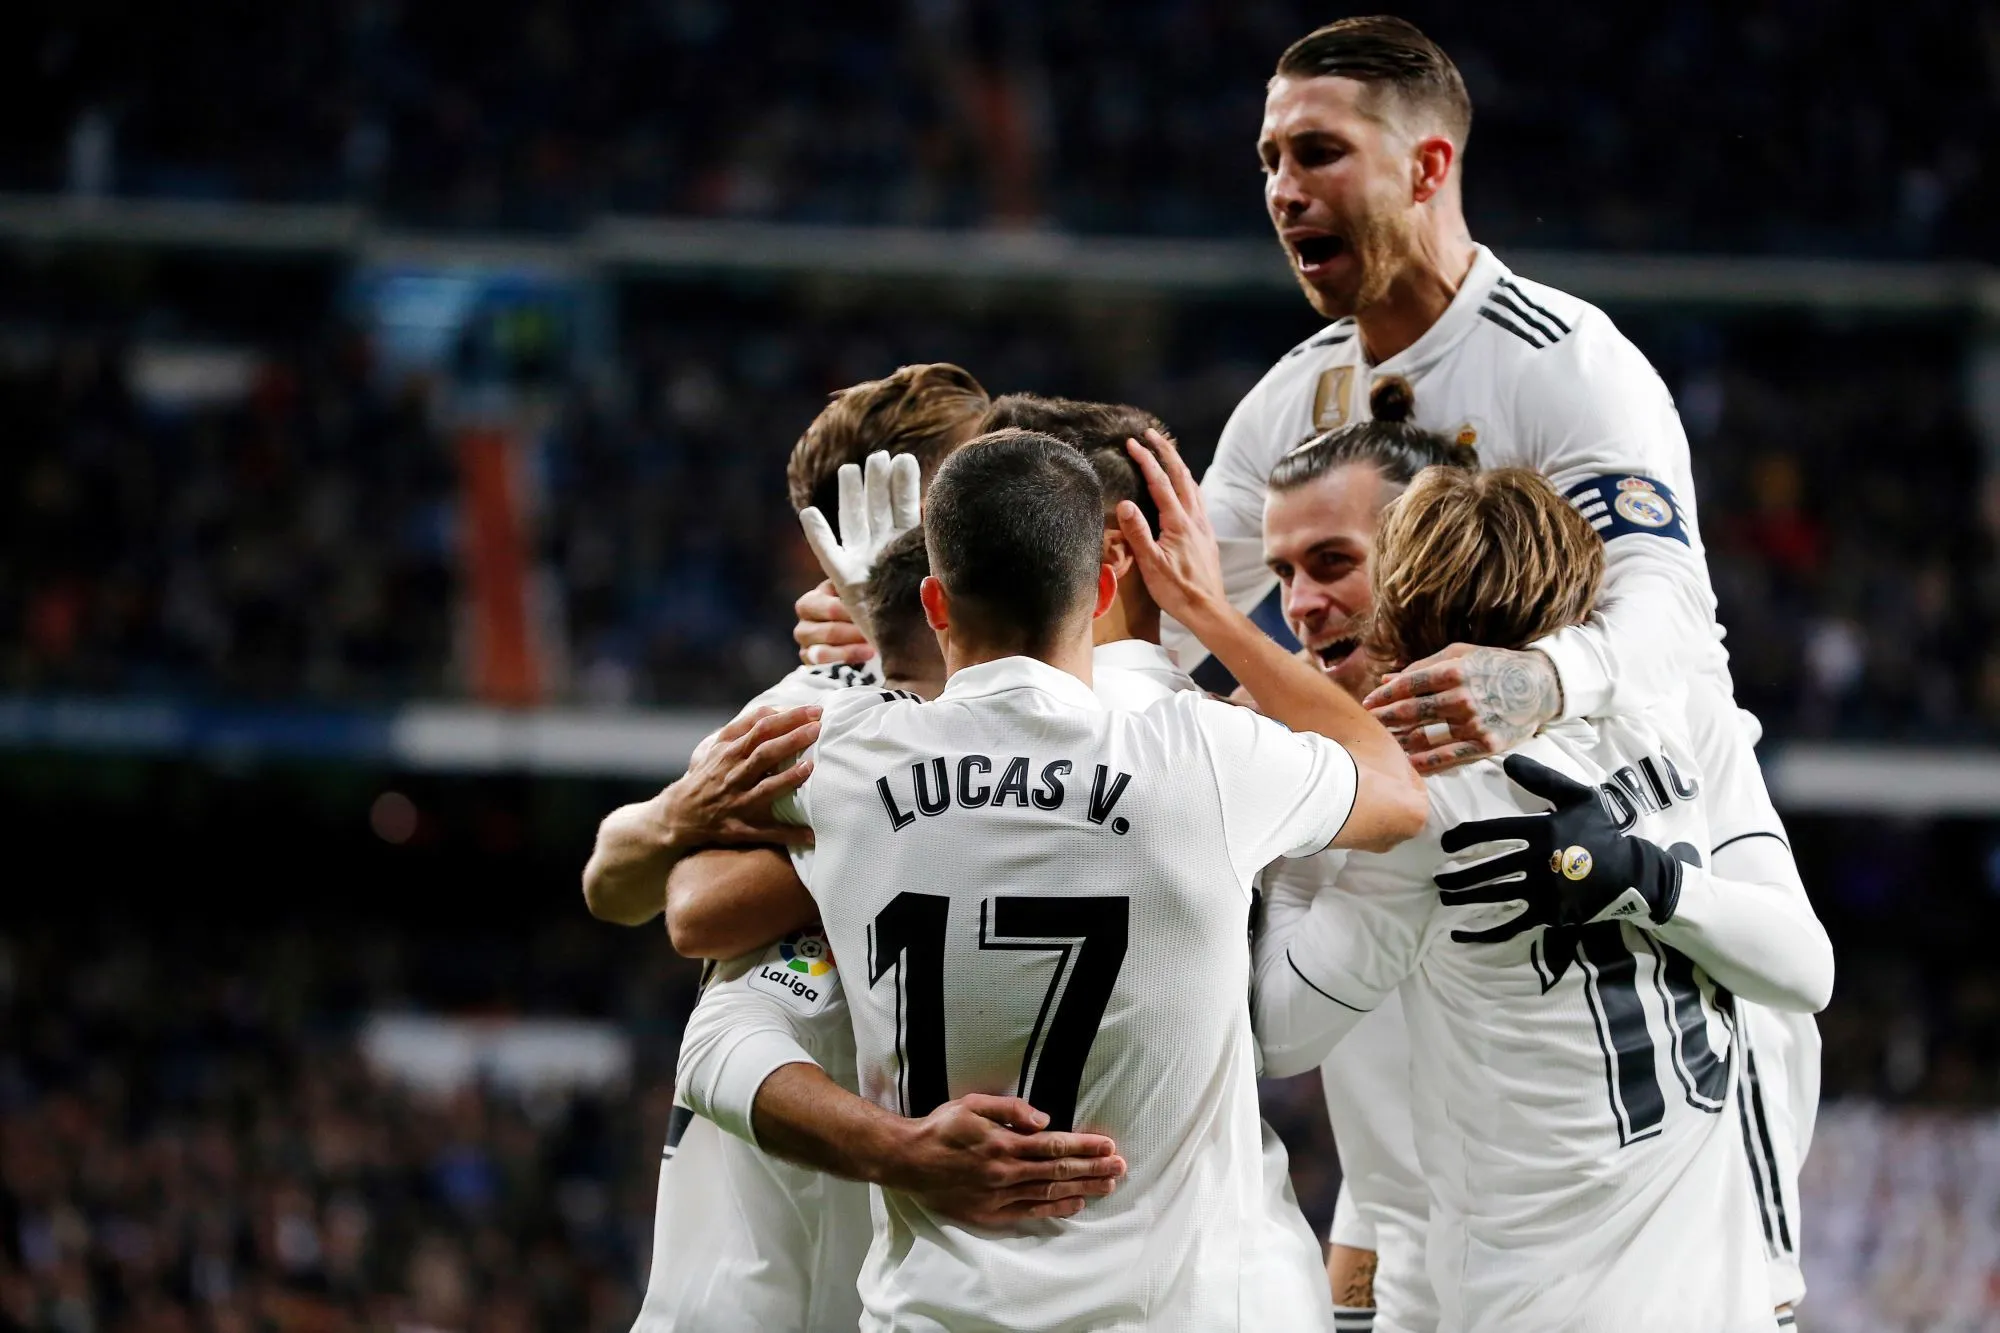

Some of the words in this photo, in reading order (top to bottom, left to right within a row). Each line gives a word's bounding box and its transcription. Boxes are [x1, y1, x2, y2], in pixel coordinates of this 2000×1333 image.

[876, 755, 1072, 833] LUCAS
[1087, 764, 1132, 835] V.
[760, 966, 818, 1002] LaLiga
[867, 891, 1130, 1132] 17
